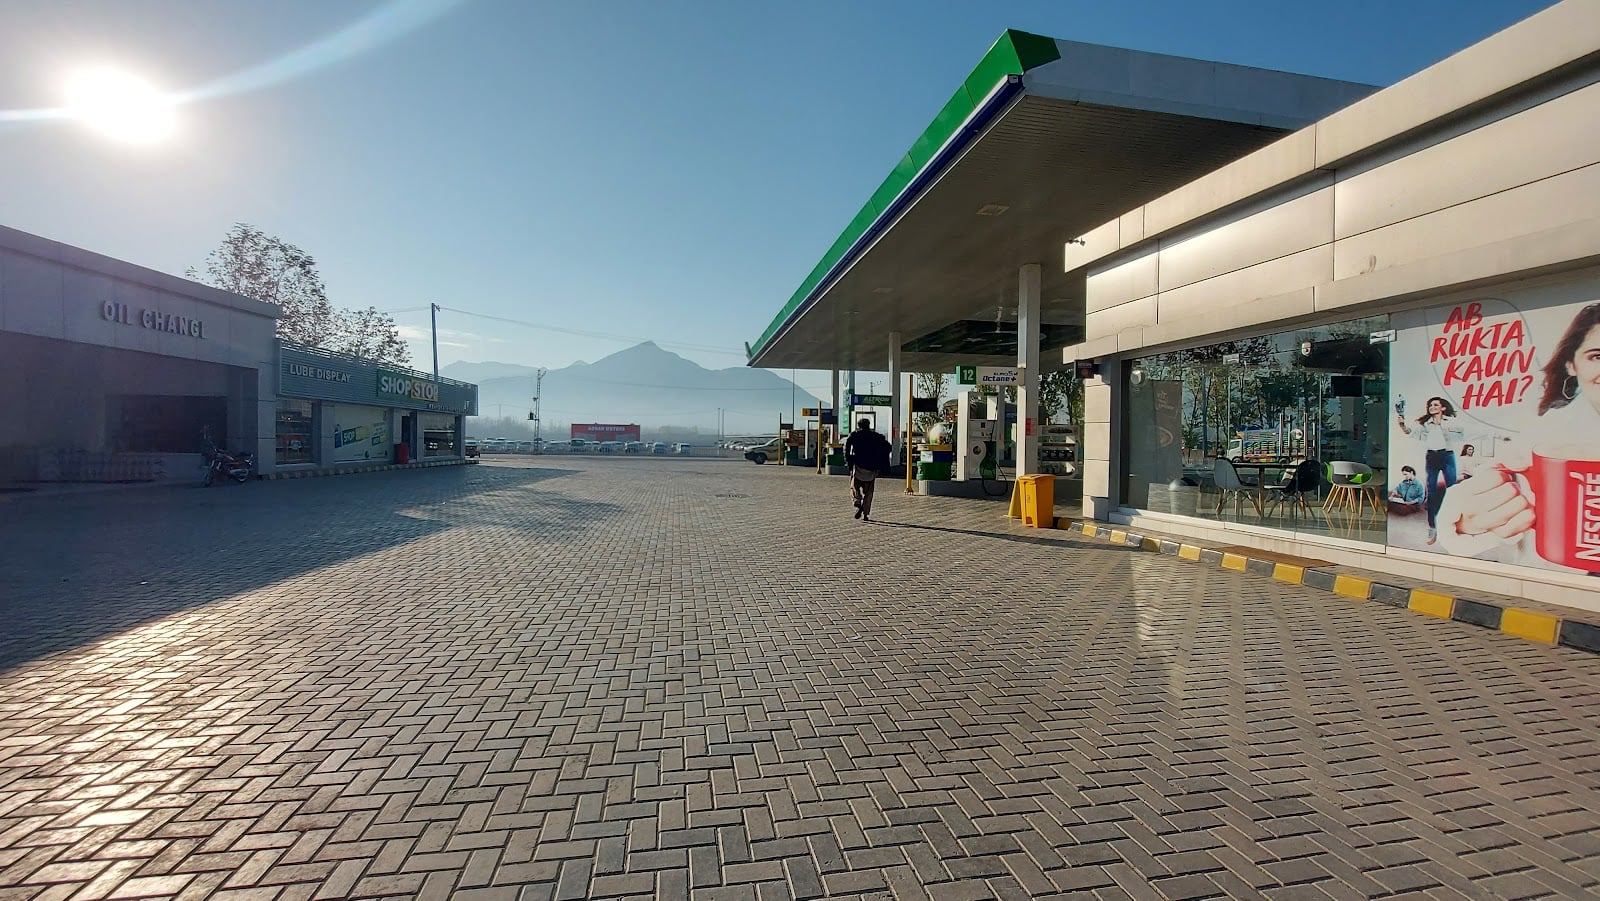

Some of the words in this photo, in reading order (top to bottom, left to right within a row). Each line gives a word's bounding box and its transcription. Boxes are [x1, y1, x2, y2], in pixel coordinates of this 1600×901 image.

[103, 300, 133, 326] OIL
[1443, 302, 1483, 334] AB
[1430, 319, 1525, 363] RUKTA
[289, 364, 314, 377] LUBE
[316, 368, 352, 384] DISPLAY
[962, 369, 975, 381] 12
[1443, 345, 1536, 386] KAUN
[380, 376, 411, 396] SHOP
[413, 382, 438, 400] STOP
[1461, 375, 1534, 410] HAI?
